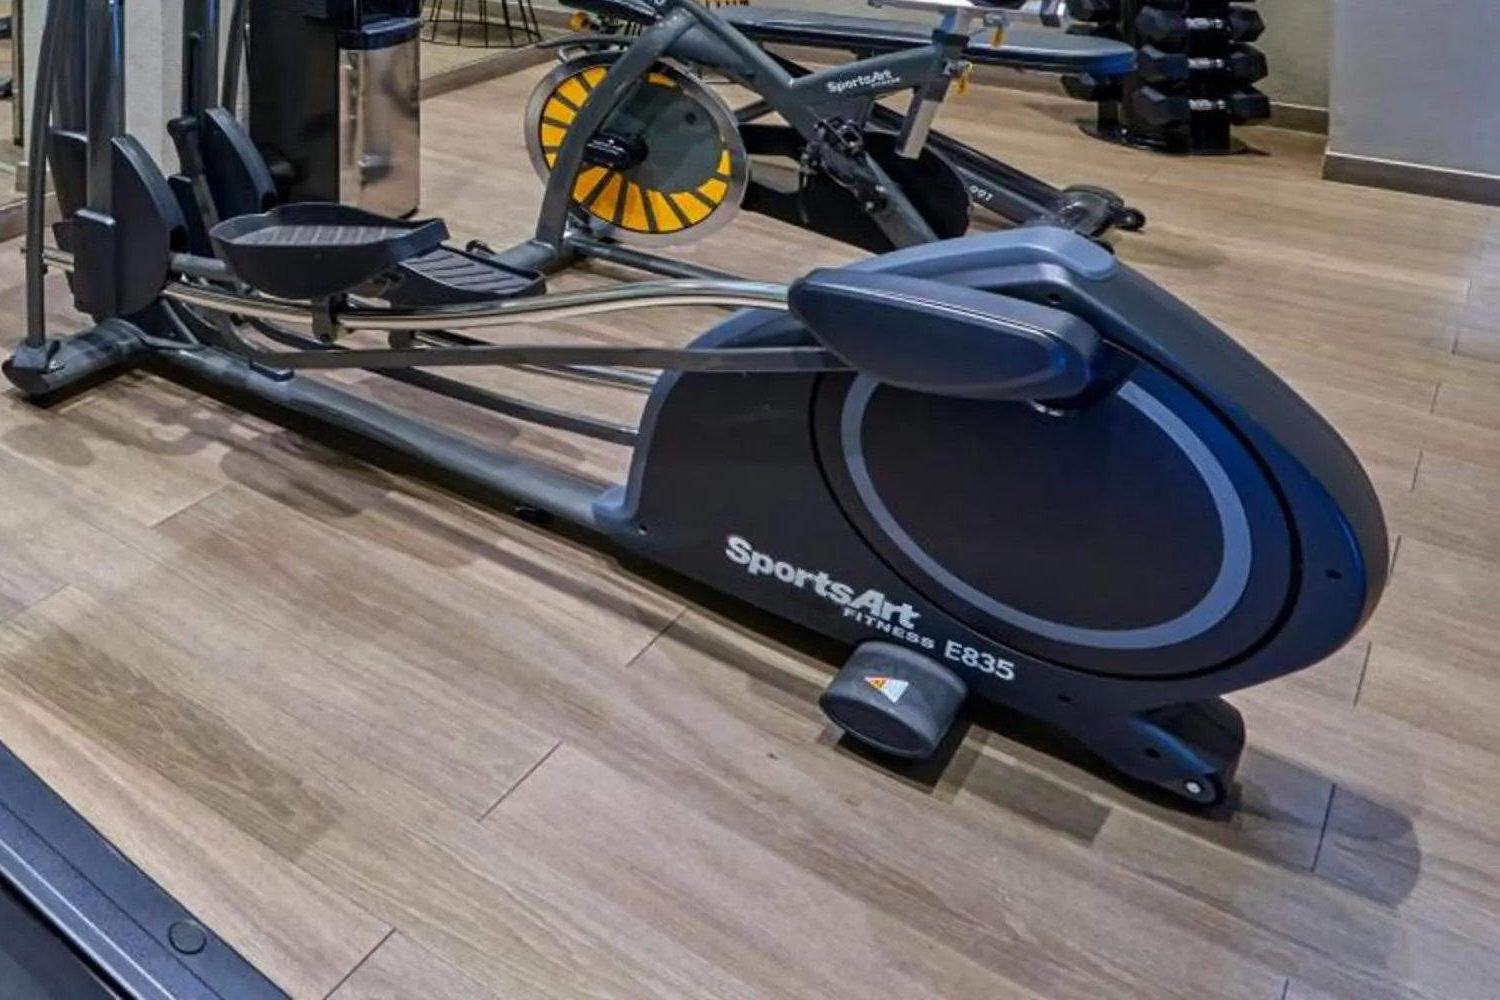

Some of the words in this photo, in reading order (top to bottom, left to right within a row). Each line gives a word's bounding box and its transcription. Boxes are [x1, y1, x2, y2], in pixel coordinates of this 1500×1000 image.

[725, 534, 921, 630] SportsArt
[843, 607, 935, 650] FITNESS
[944, 639, 1017, 682] E835
